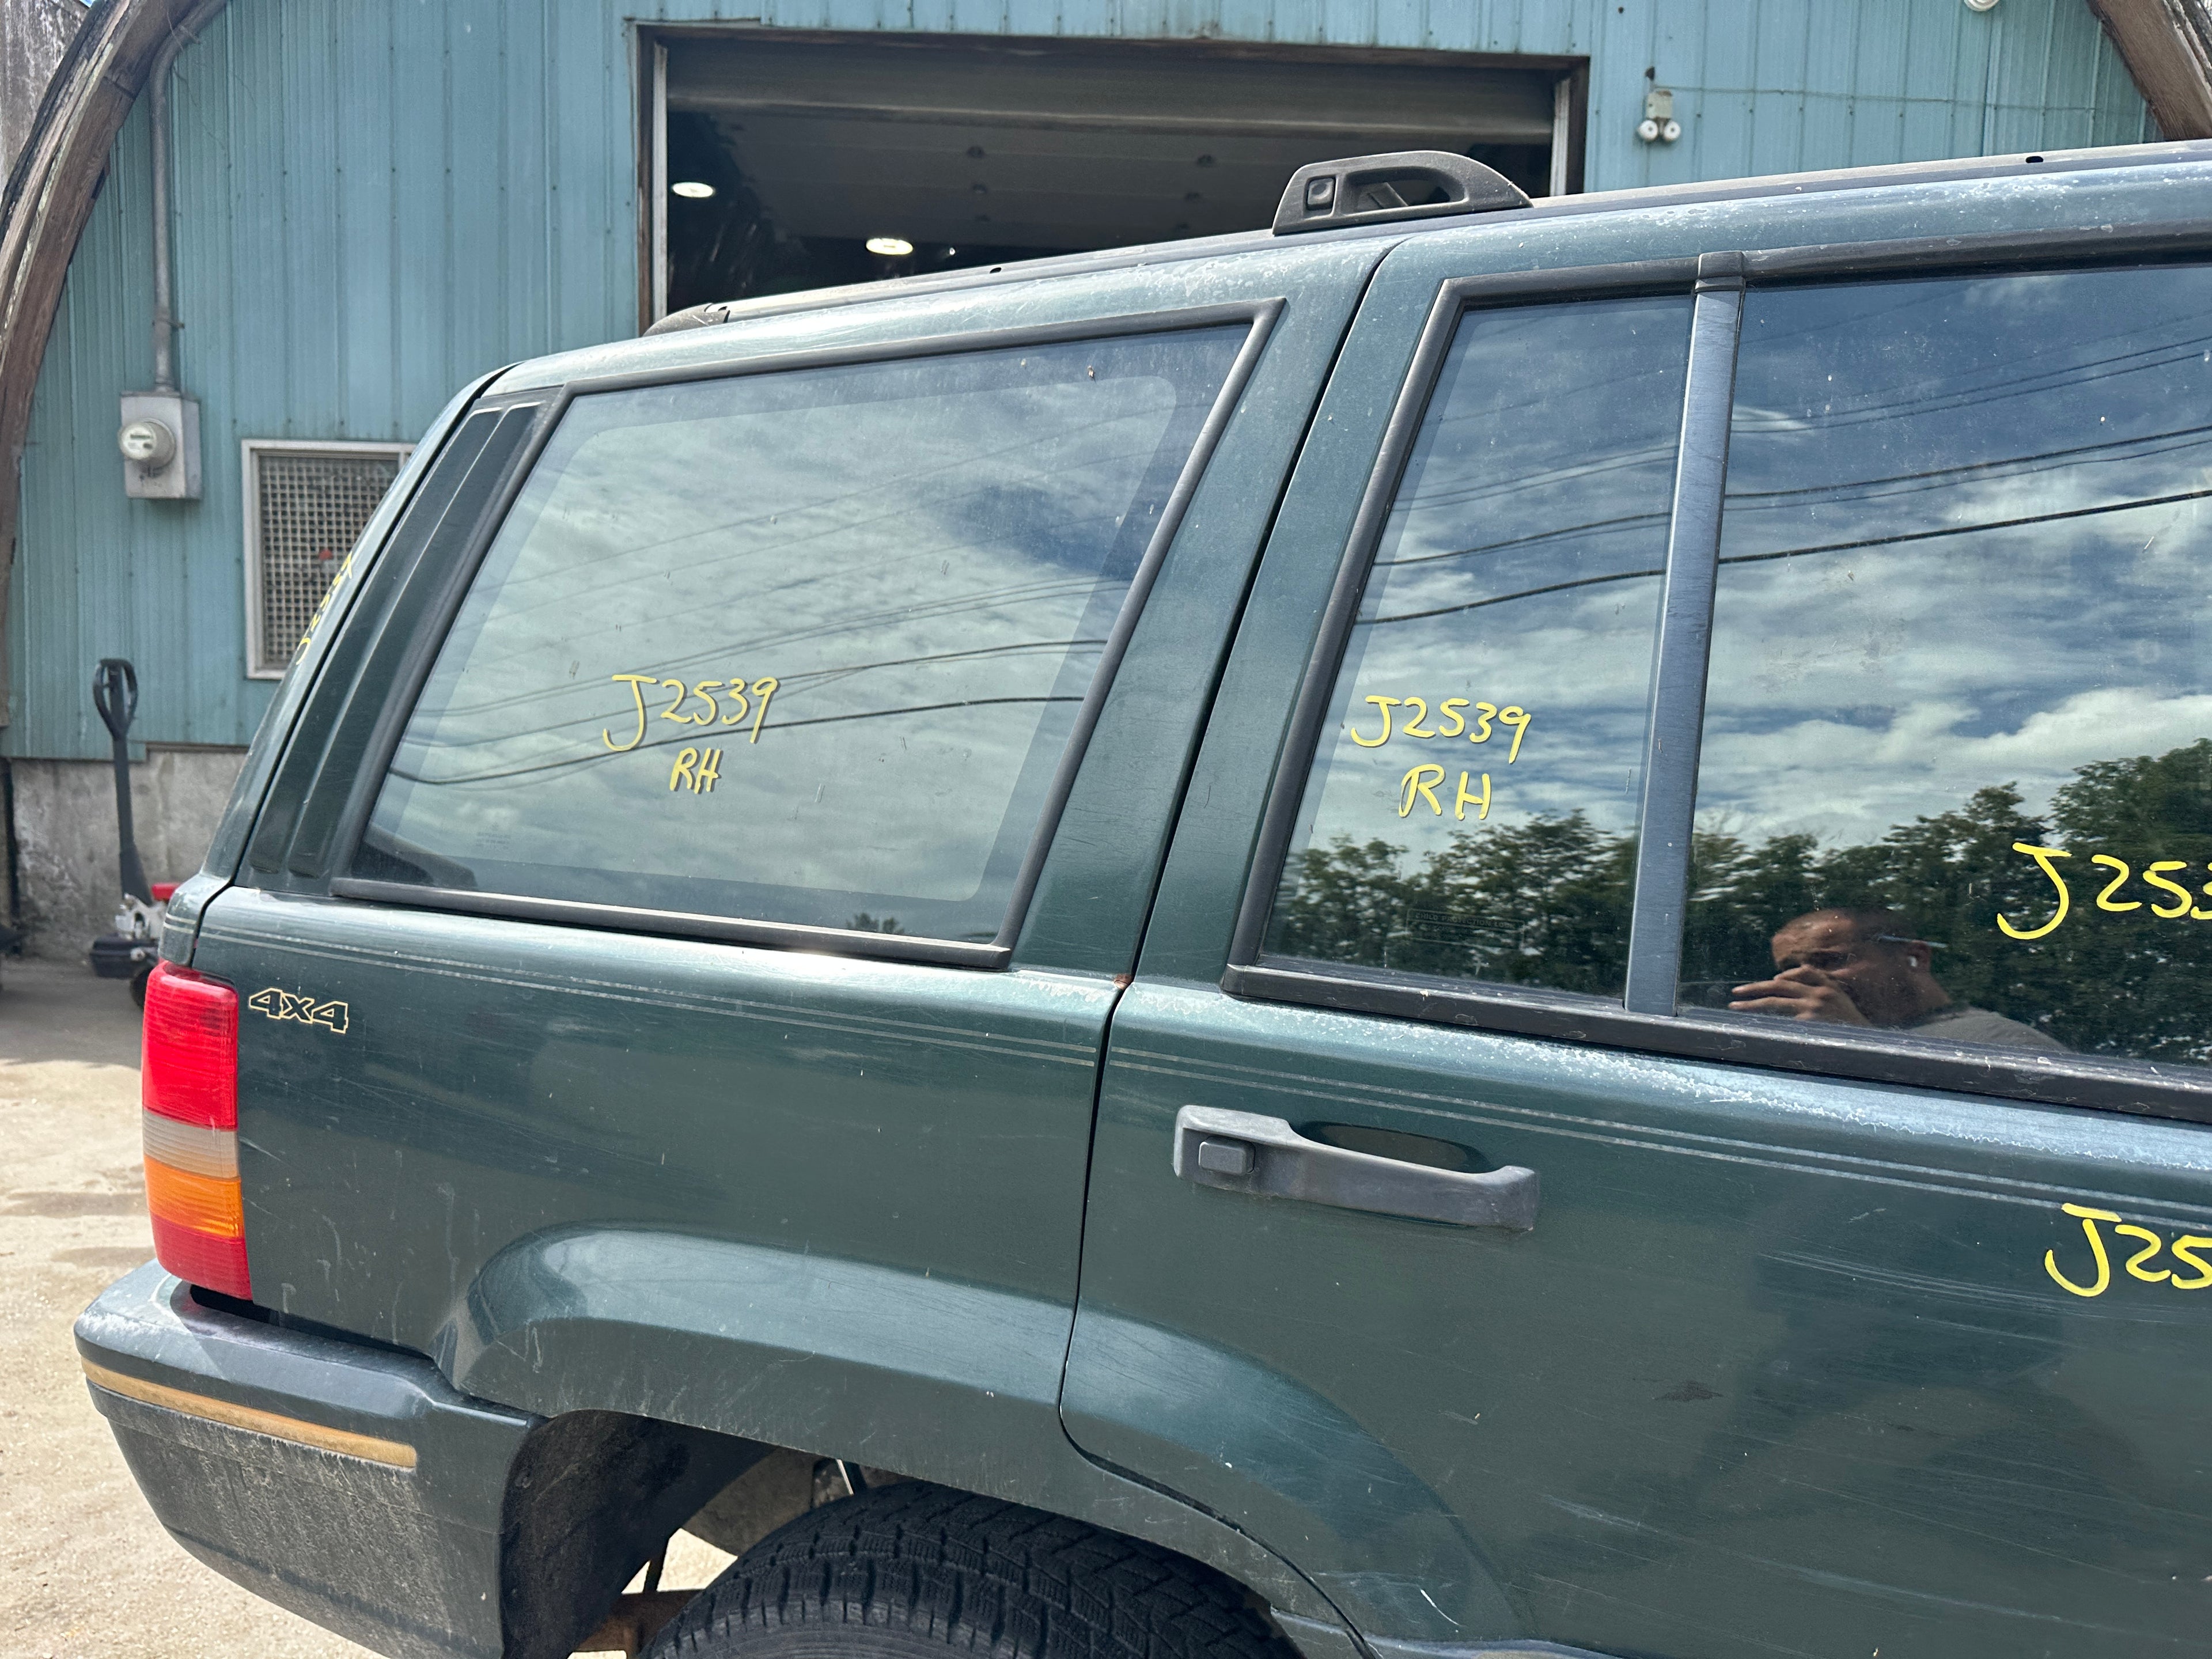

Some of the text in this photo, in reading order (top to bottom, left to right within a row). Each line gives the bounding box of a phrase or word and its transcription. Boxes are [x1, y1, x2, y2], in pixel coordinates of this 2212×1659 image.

[603, 675, 778, 751] J2539
[1351, 695, 1531, 764] J2539
[669, 747, 720, 794] RH
[1399, 764, 1491, 820] RH
[2045, 1202, 2212, 1297] J25
